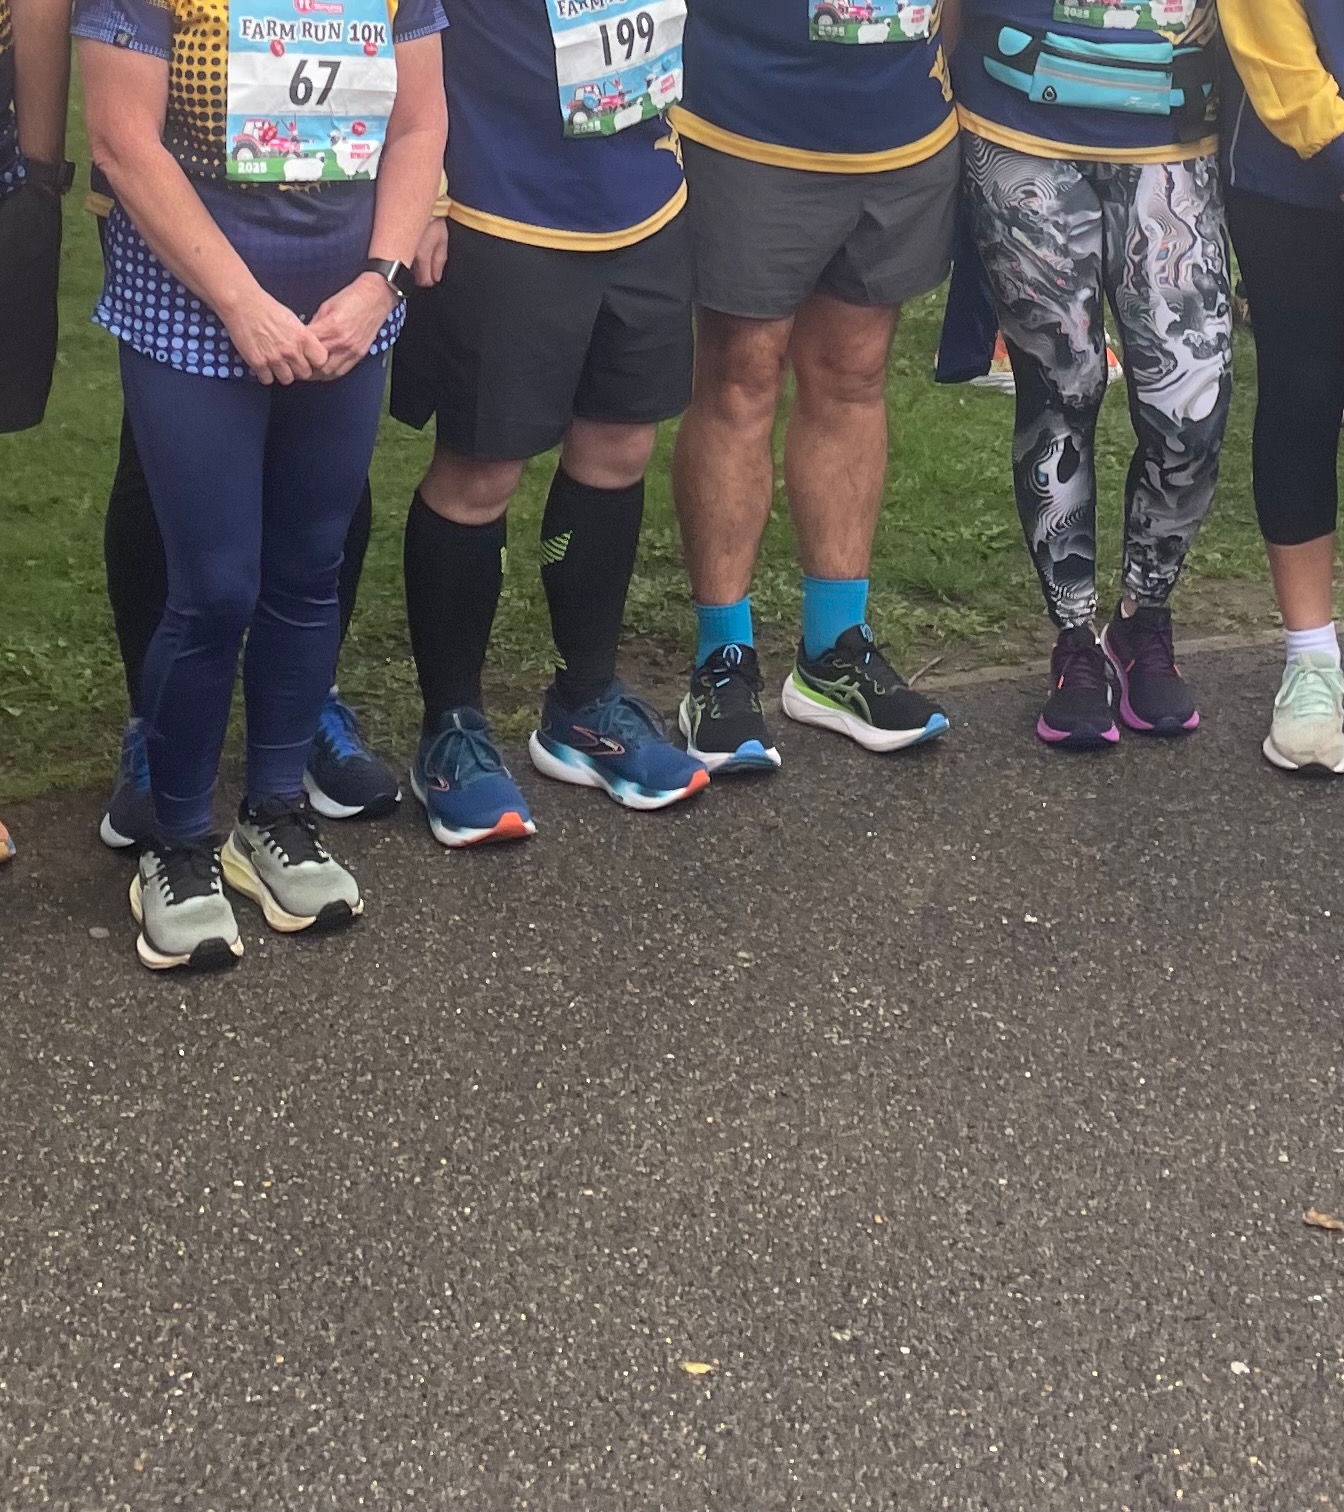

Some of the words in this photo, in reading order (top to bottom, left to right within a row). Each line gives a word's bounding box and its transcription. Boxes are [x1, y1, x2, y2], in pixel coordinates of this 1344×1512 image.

[241, 19, 295, 40] FARM
[302, 20, 342, 41] RUN
[349, 23, 386, 43] 10K
[600, 12, 655, 66] 199
[289, 60, 341, 106] 67
